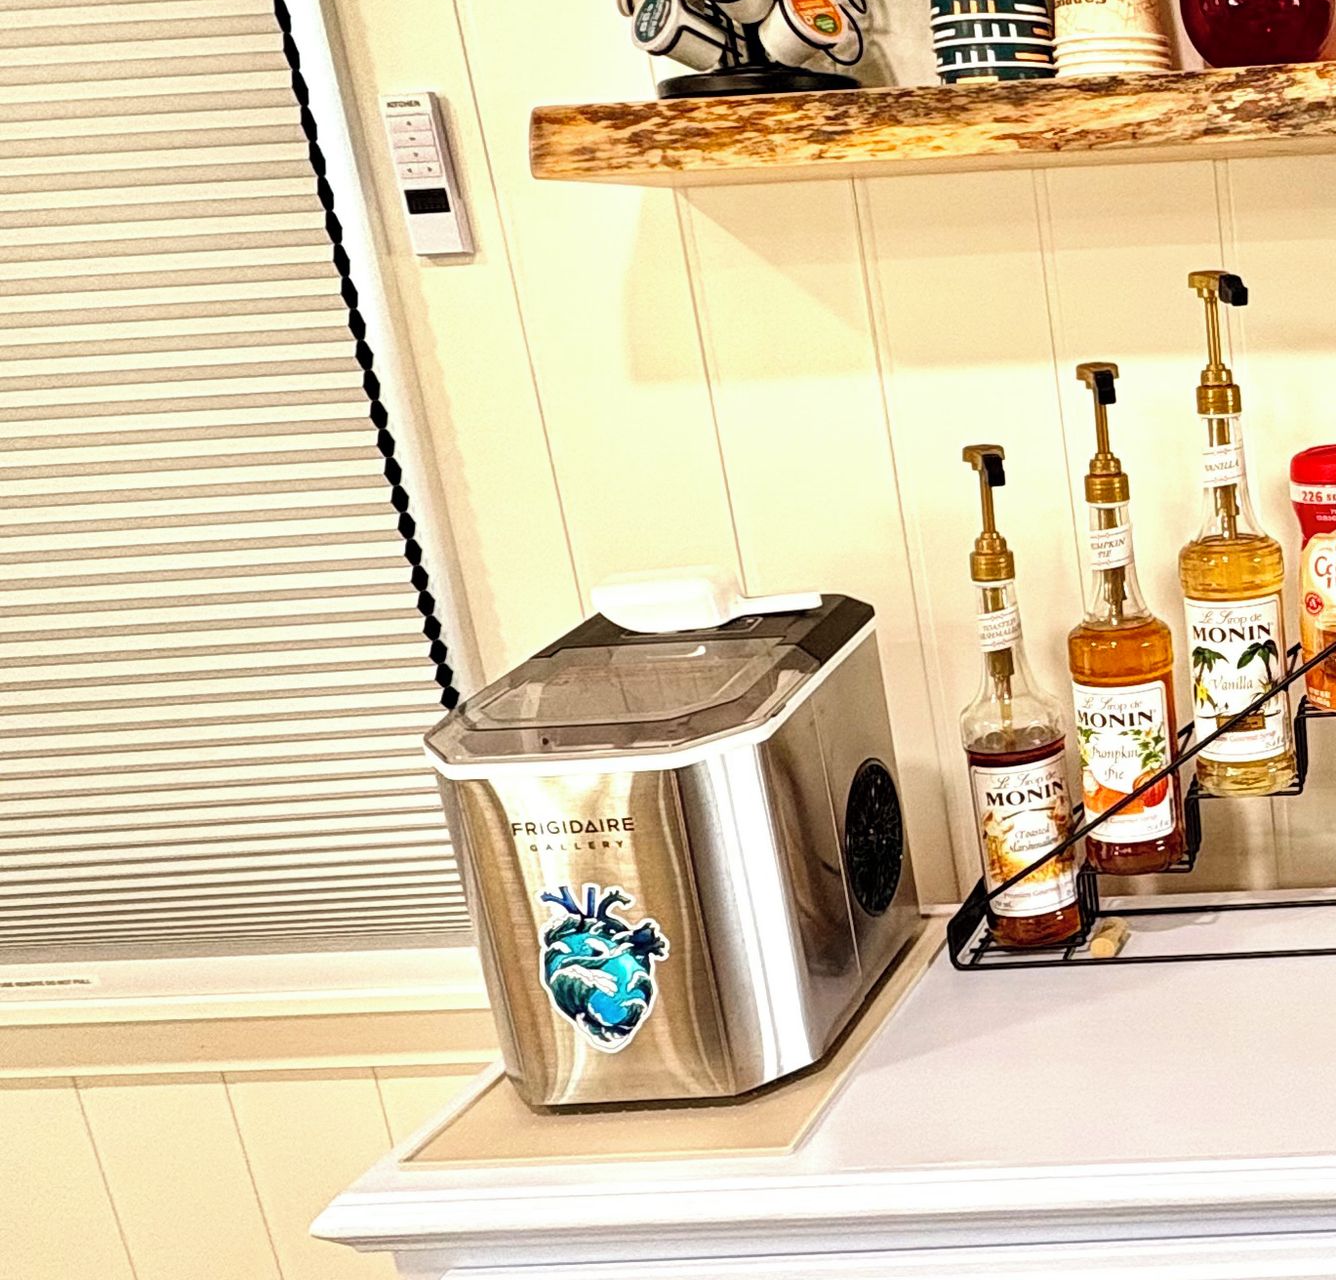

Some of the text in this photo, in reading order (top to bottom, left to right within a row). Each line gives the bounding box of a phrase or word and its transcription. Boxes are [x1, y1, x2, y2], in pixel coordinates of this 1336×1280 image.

[1302, 491, 1323, 502] 226
[1193, 622, 1271, 643] MONIN
[1211, 675, 1253, 691] Vanilla
[1077, 709, 1153, 729] MONIN
[986, 776, 1065, 807] MONIN
[511, 817, 635, 836] FRIGIDAIRE
[530, 841, 623, 852] GALLERY
